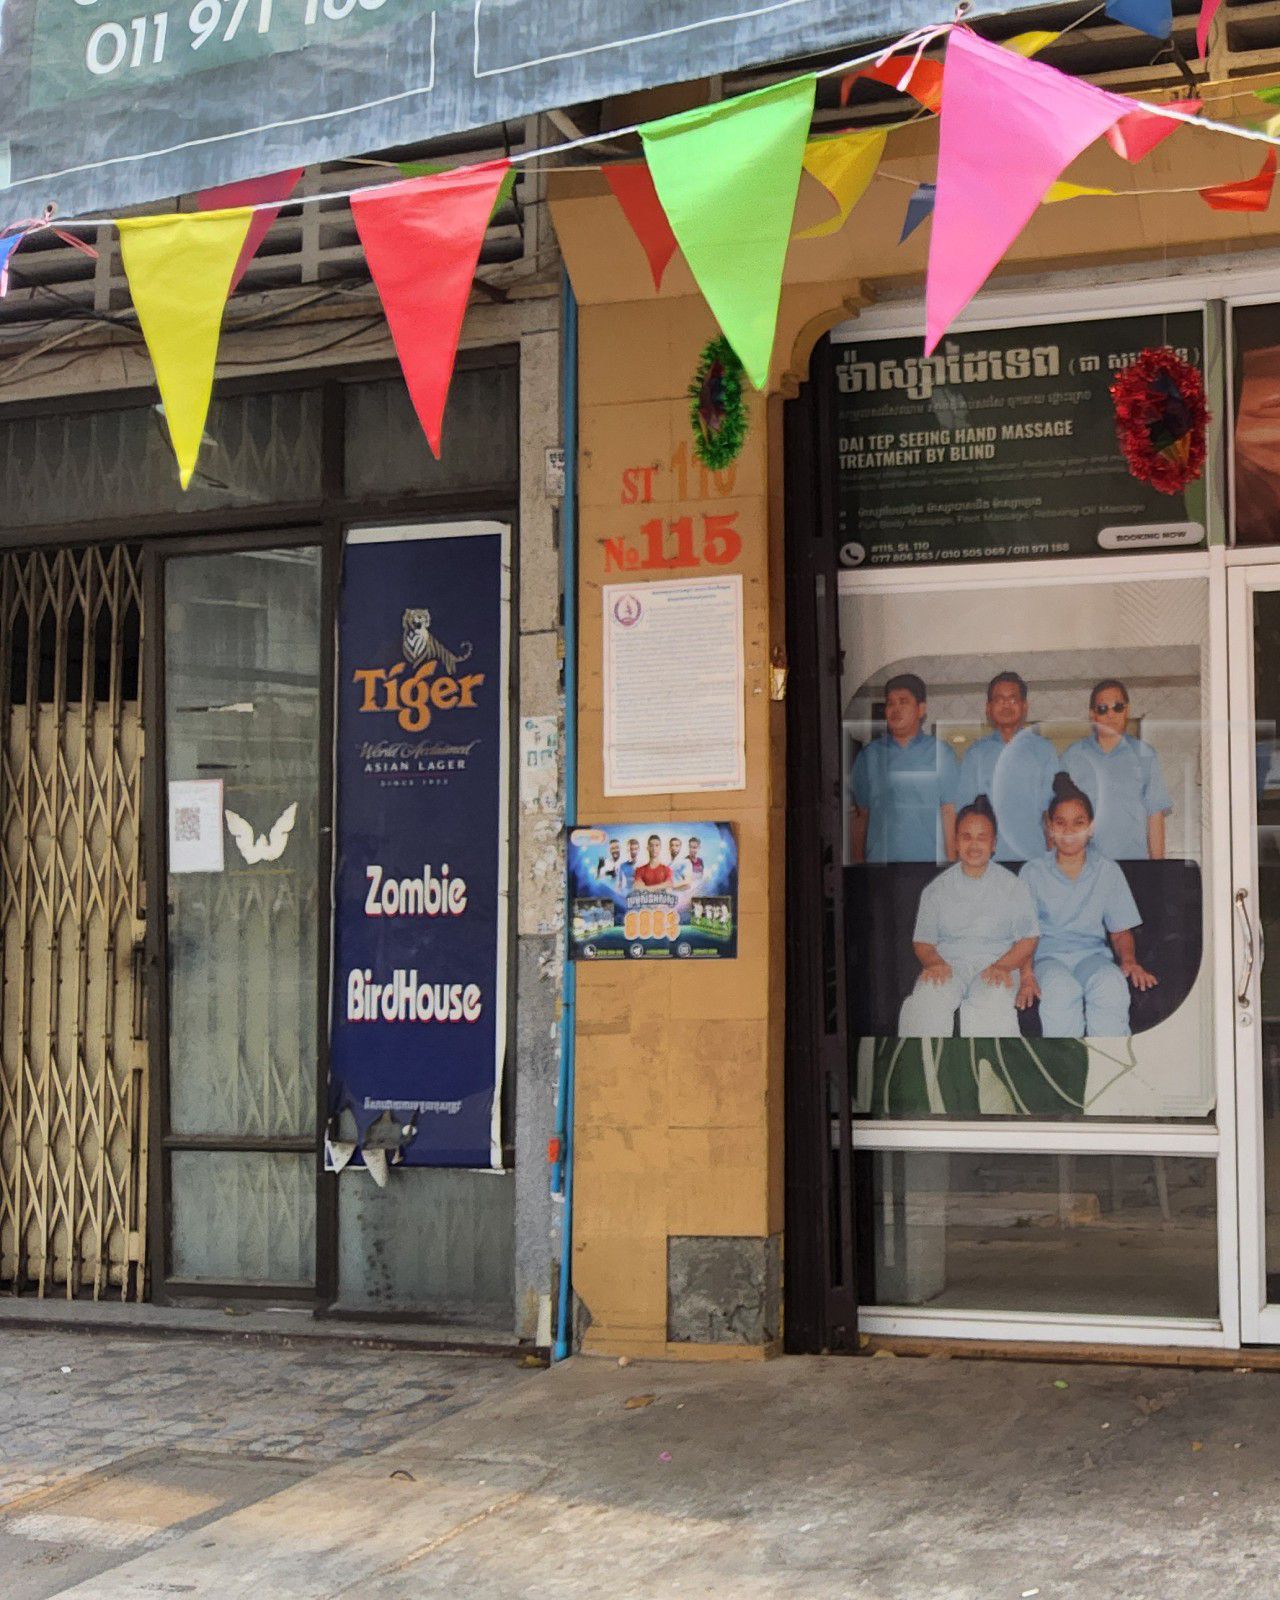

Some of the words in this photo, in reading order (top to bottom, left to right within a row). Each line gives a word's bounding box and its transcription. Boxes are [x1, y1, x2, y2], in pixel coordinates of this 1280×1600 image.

[85, 12, 168, 75] 011
[188, 0, 273, 50] 971
[838, 449, 921, 470] TREATMENT
[926, 448, 946, 463] BY
[950, 444, 996, 462] BLIND
[839, 437, 864, 453] DAI
[868, 434, 895, 450] TEP
[900, 430, 950, 448] SEEING
[955, 427, 998, 443] HAND
[1001, 420, 1074, 440] MASSAGE
[621, 465, 660, 504] ST
[353, 660, 485, 732] Tiger
[364, 762, 409, 773] ASIAN
[418, 760, 466, 771] LAGER
[365, 863, 468, 916] Zombie
[347, 968, 483, 1024] BirdHouse
